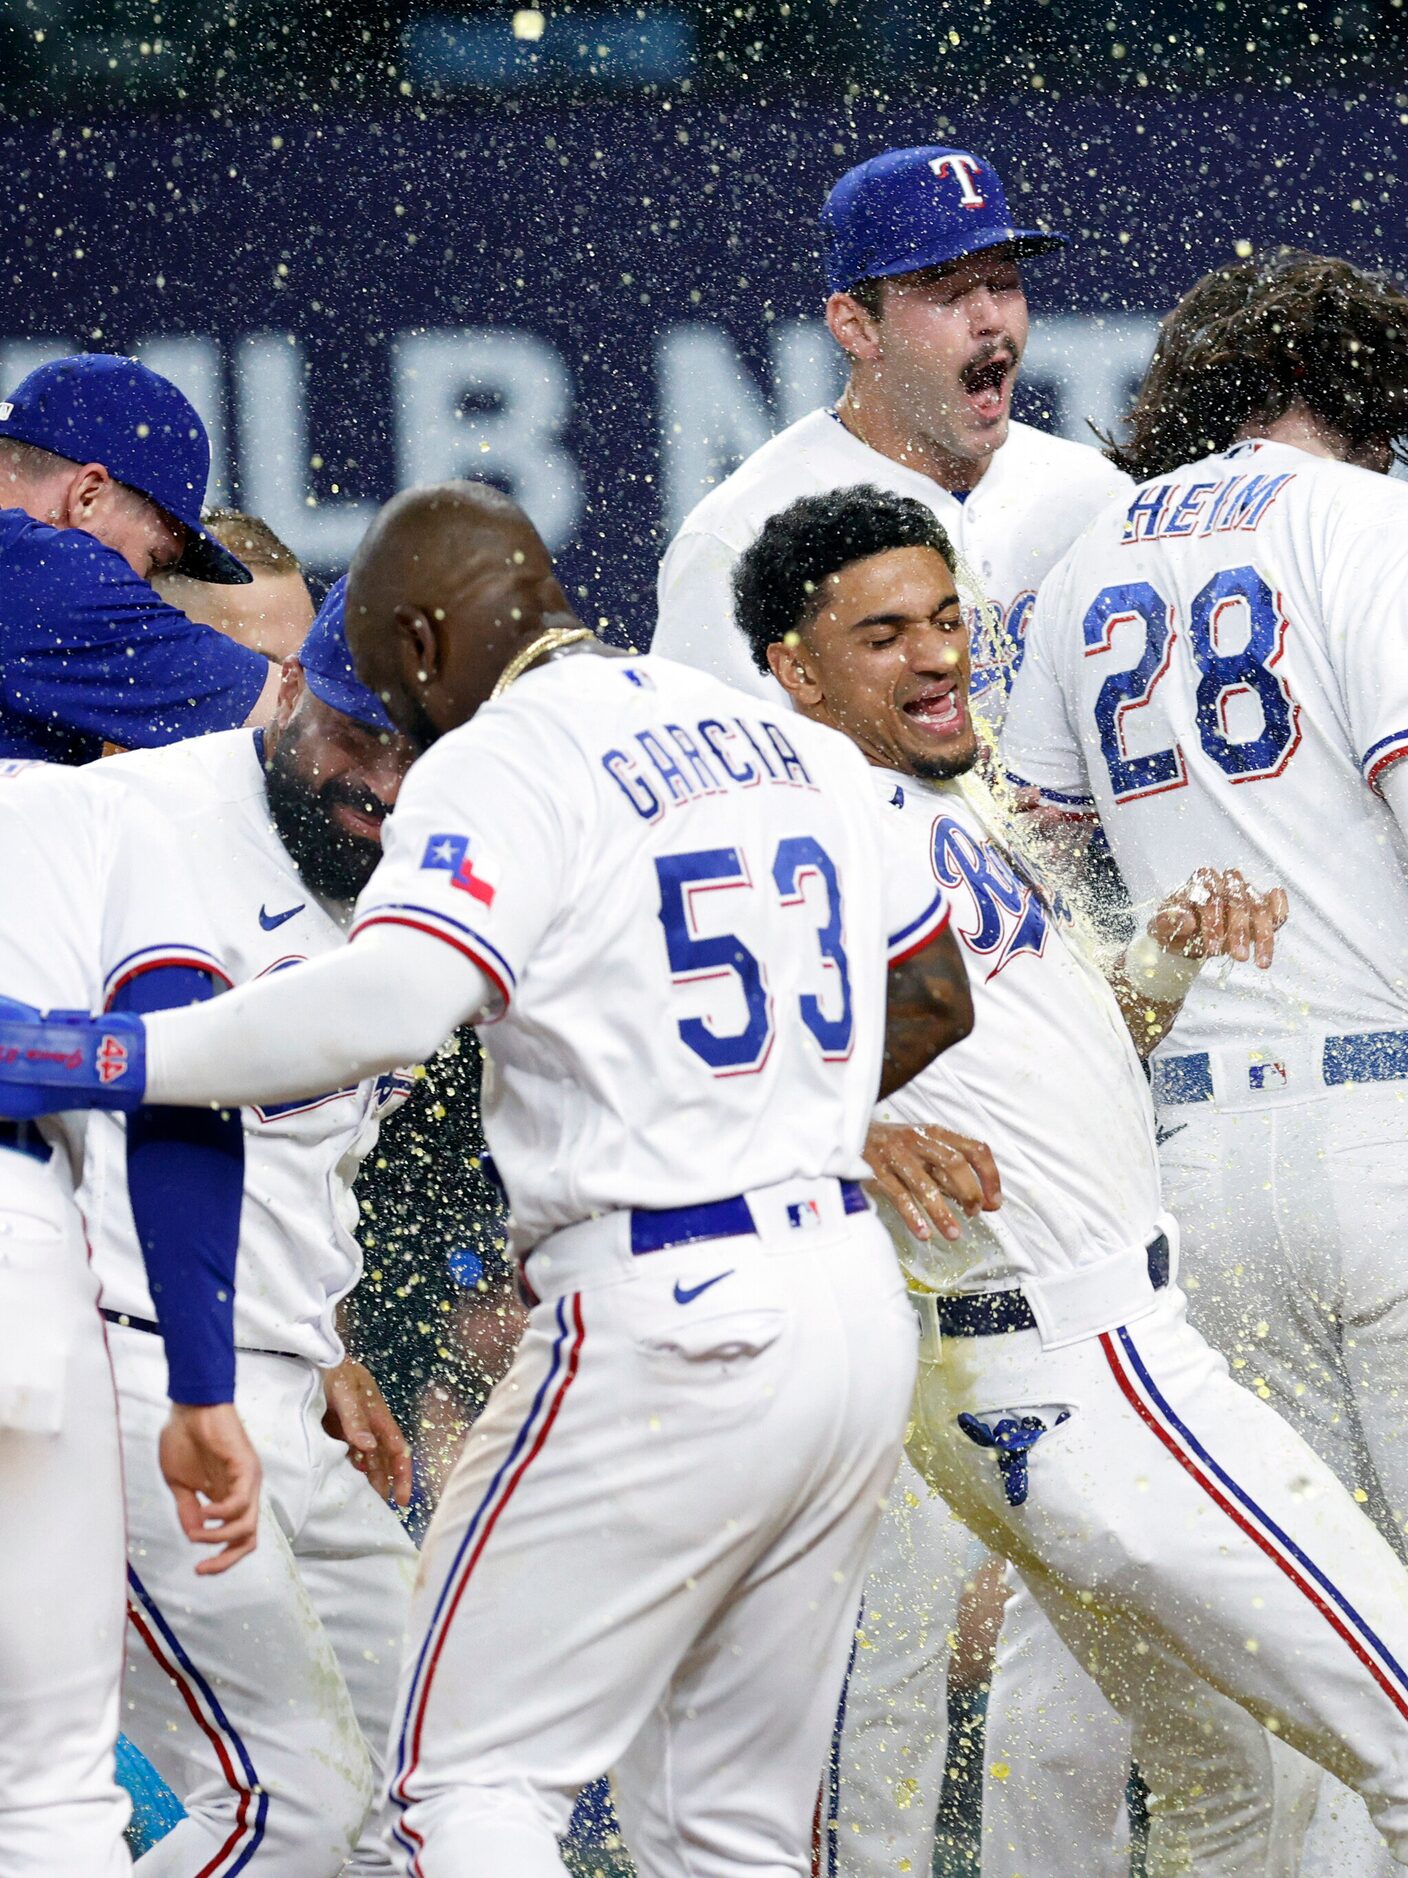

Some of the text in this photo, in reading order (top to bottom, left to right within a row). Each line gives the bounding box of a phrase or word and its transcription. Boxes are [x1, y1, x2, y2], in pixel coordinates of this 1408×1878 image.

[928, 153, 986, 209] T
[1120, 473, 1298, 546] HEIM
[1082, 565, 1302, 805] 28
[601, 717, 822, 827] GARCIA
[653, 836, 856, 1079] 53
